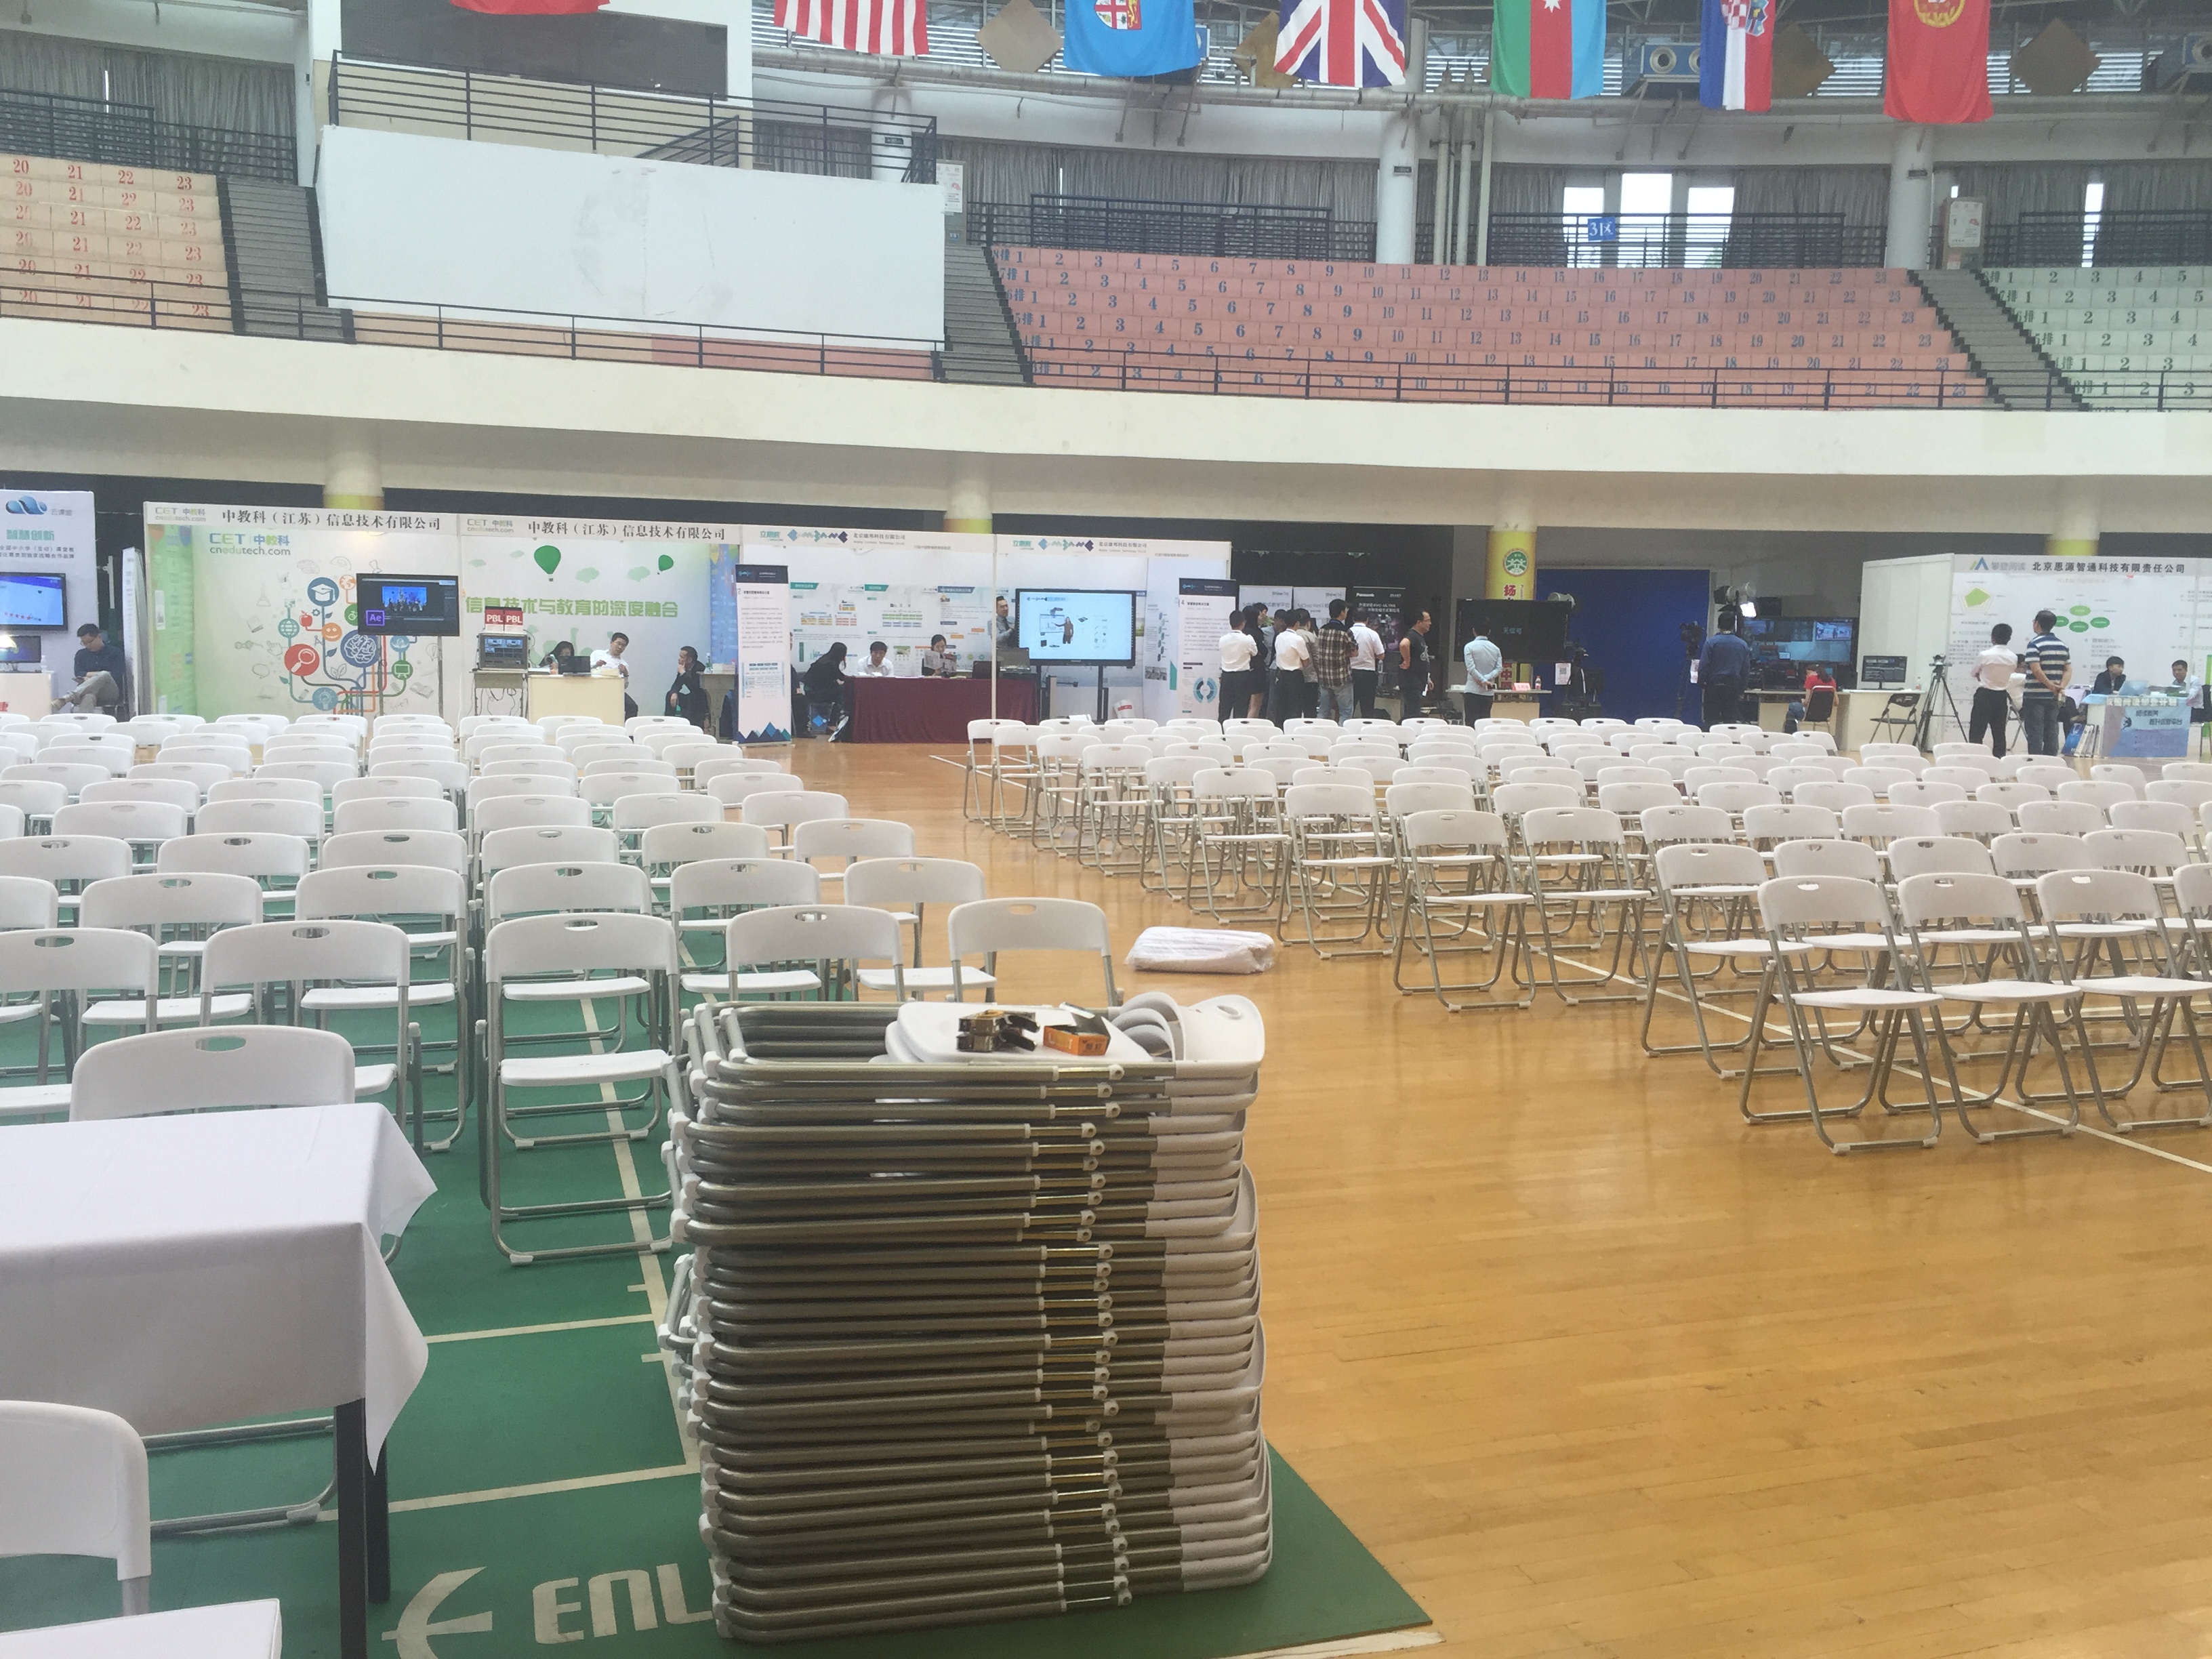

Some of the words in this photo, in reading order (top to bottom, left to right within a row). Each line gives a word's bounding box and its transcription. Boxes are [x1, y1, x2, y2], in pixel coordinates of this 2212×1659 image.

[14, 159, 30, 173] 20
[68, 165, 83, 180] 21
[119, 171, 134, 186] 22
[177, 176, 192, 191] 23
[16, 182, 33, 197] 20
[68, 186, 84, 201] 21
[70, 211, 86, 226] 21
[125, 216, 141, 231] 22
[1589, 221, 1613, 237] 3区
[73, 239, 88, 253] 21
[186, 247, 202, 262] 23
[1017, 251, 1023, 263] 1
[1054, 252, 1064, 266] 2
[1095, 255, 1103, 268] 3
[1133, 257, 1142, 270] 4
[1171, 258, 1181, 270] 5
[1210, 260, 1218, 273] 6
[1248, 260, 1256, 274] 7
[1286, 263, 1295, 276] 8
[1325, 264, 1334, 277] 9
[2007, 271, 2014, 283] 1
[2049, 271, 2057, 283] 2
[2091, 271, 2100, 283] 3
[2134, 270, 2143, 283] 4
[2178, 270, 2186, 282] 5
[1023, 270, 1030, 283] 1
[1060, 272, 1069, 285] 2
[1101, 275, 1109, 287] 3
[1139, 277, 1148, 290] 4
[1178, 279, 1186, 291] 5
[1218, 281, 1227, 293] 6
[1256, 281, 1265, 294] 7
[1295, 283, 1304, 295] 8
[1334, 283, 1343, 297] 9
[2025, 291, 2032, 304] 1
[2065, 291, 2074, 303] 2
[2108, 290, 2116, 302] 3
[2149, 290, 2158, 302] 4
[2194, 290, 2203, 302] 5
[1031, 291, 1038, 304] 1
[1068, 293, 1077, 306] 2
[1109, 294, 1118, 308] 3
[1149, 298, 1158, 310] 4
[1189, 298, 1197, 311] 5
[1227, 301, 1236, 314] 6
[1266, 302, 1275, 314] 7
[1303, 304, 1312, 317] 8
[1343, 305, 1352, 317] 9
[2042, 312, 2048, 324] 1
[2084, 312, 2093, 324] 2
[2127, 312, 2135, 324] 3
[2171, 311, 2179, 323] 4
[1040, 314, 1046, 327] 1
[1076, 316, 1085, 329] 2
[1116, 318, 1125, 331] 3
[1155, 321, 1164, 333] 4
[1194, 323, 1203, 335] 5
[1236, 324, 1245, 337] 6
[1275, 325, 1284, 337] 7
[1313, 327, 1322, 340] 8
[1353, 328, 1362, 340] 9
[2062, 334, 2067, 346] 1
[2102, 333, 2110, 346] 2
[2144, 333, 2152, 346] 3
[2188, 333, 2197, 346] 4
[155, 507, 178, 515] CET
[222, 509, 441, 531] 中教科（江苏）信息技术有限公司
[467, 518, 488, 527] CET
[527, 520, 726, 541] 中教科（江苏）信息技术有限公司
[209, 533, 245, 545] CET
[253, 534, 290, 546] 中教科
[209, 546, 291, 556] cnedutech.com
[2032, 562, 2186, 574] 北京思源智通科技有限责任公司
[1504, 584, 1516, 596] 扬
[369, 613, 382, 622] Ae
[487, 614, 504, 623] PBL
[506, 615, 523, 624] PBL
[1500, 669, 1513, 681] 中
